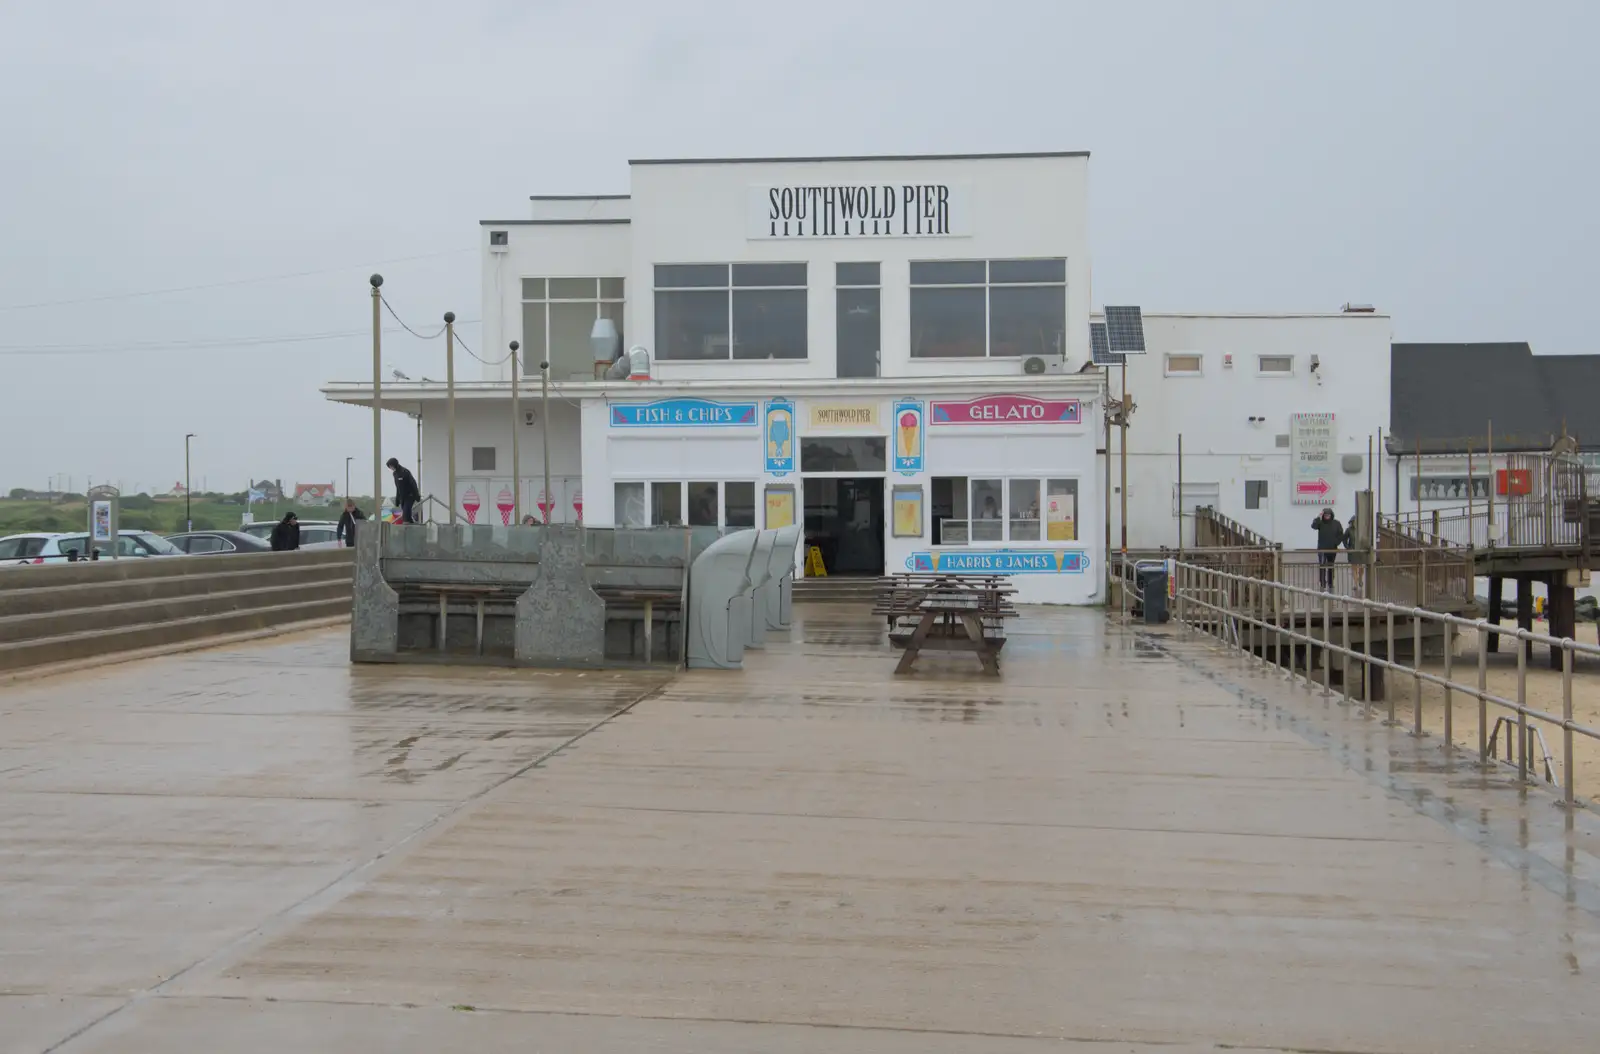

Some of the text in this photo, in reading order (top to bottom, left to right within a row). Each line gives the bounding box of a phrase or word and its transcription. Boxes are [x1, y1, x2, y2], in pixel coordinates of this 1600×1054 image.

[769, 185, 950, 236] SOUTHWOLD PIER
[635, 407, 733, 422] FISH & CHIPS
[817, 409, 871, 423] SOUTHWOLD PIER
[969, 404, 1045, 420] GELATO
[947, 555, 1048, 569] HARRIS & JAMES
